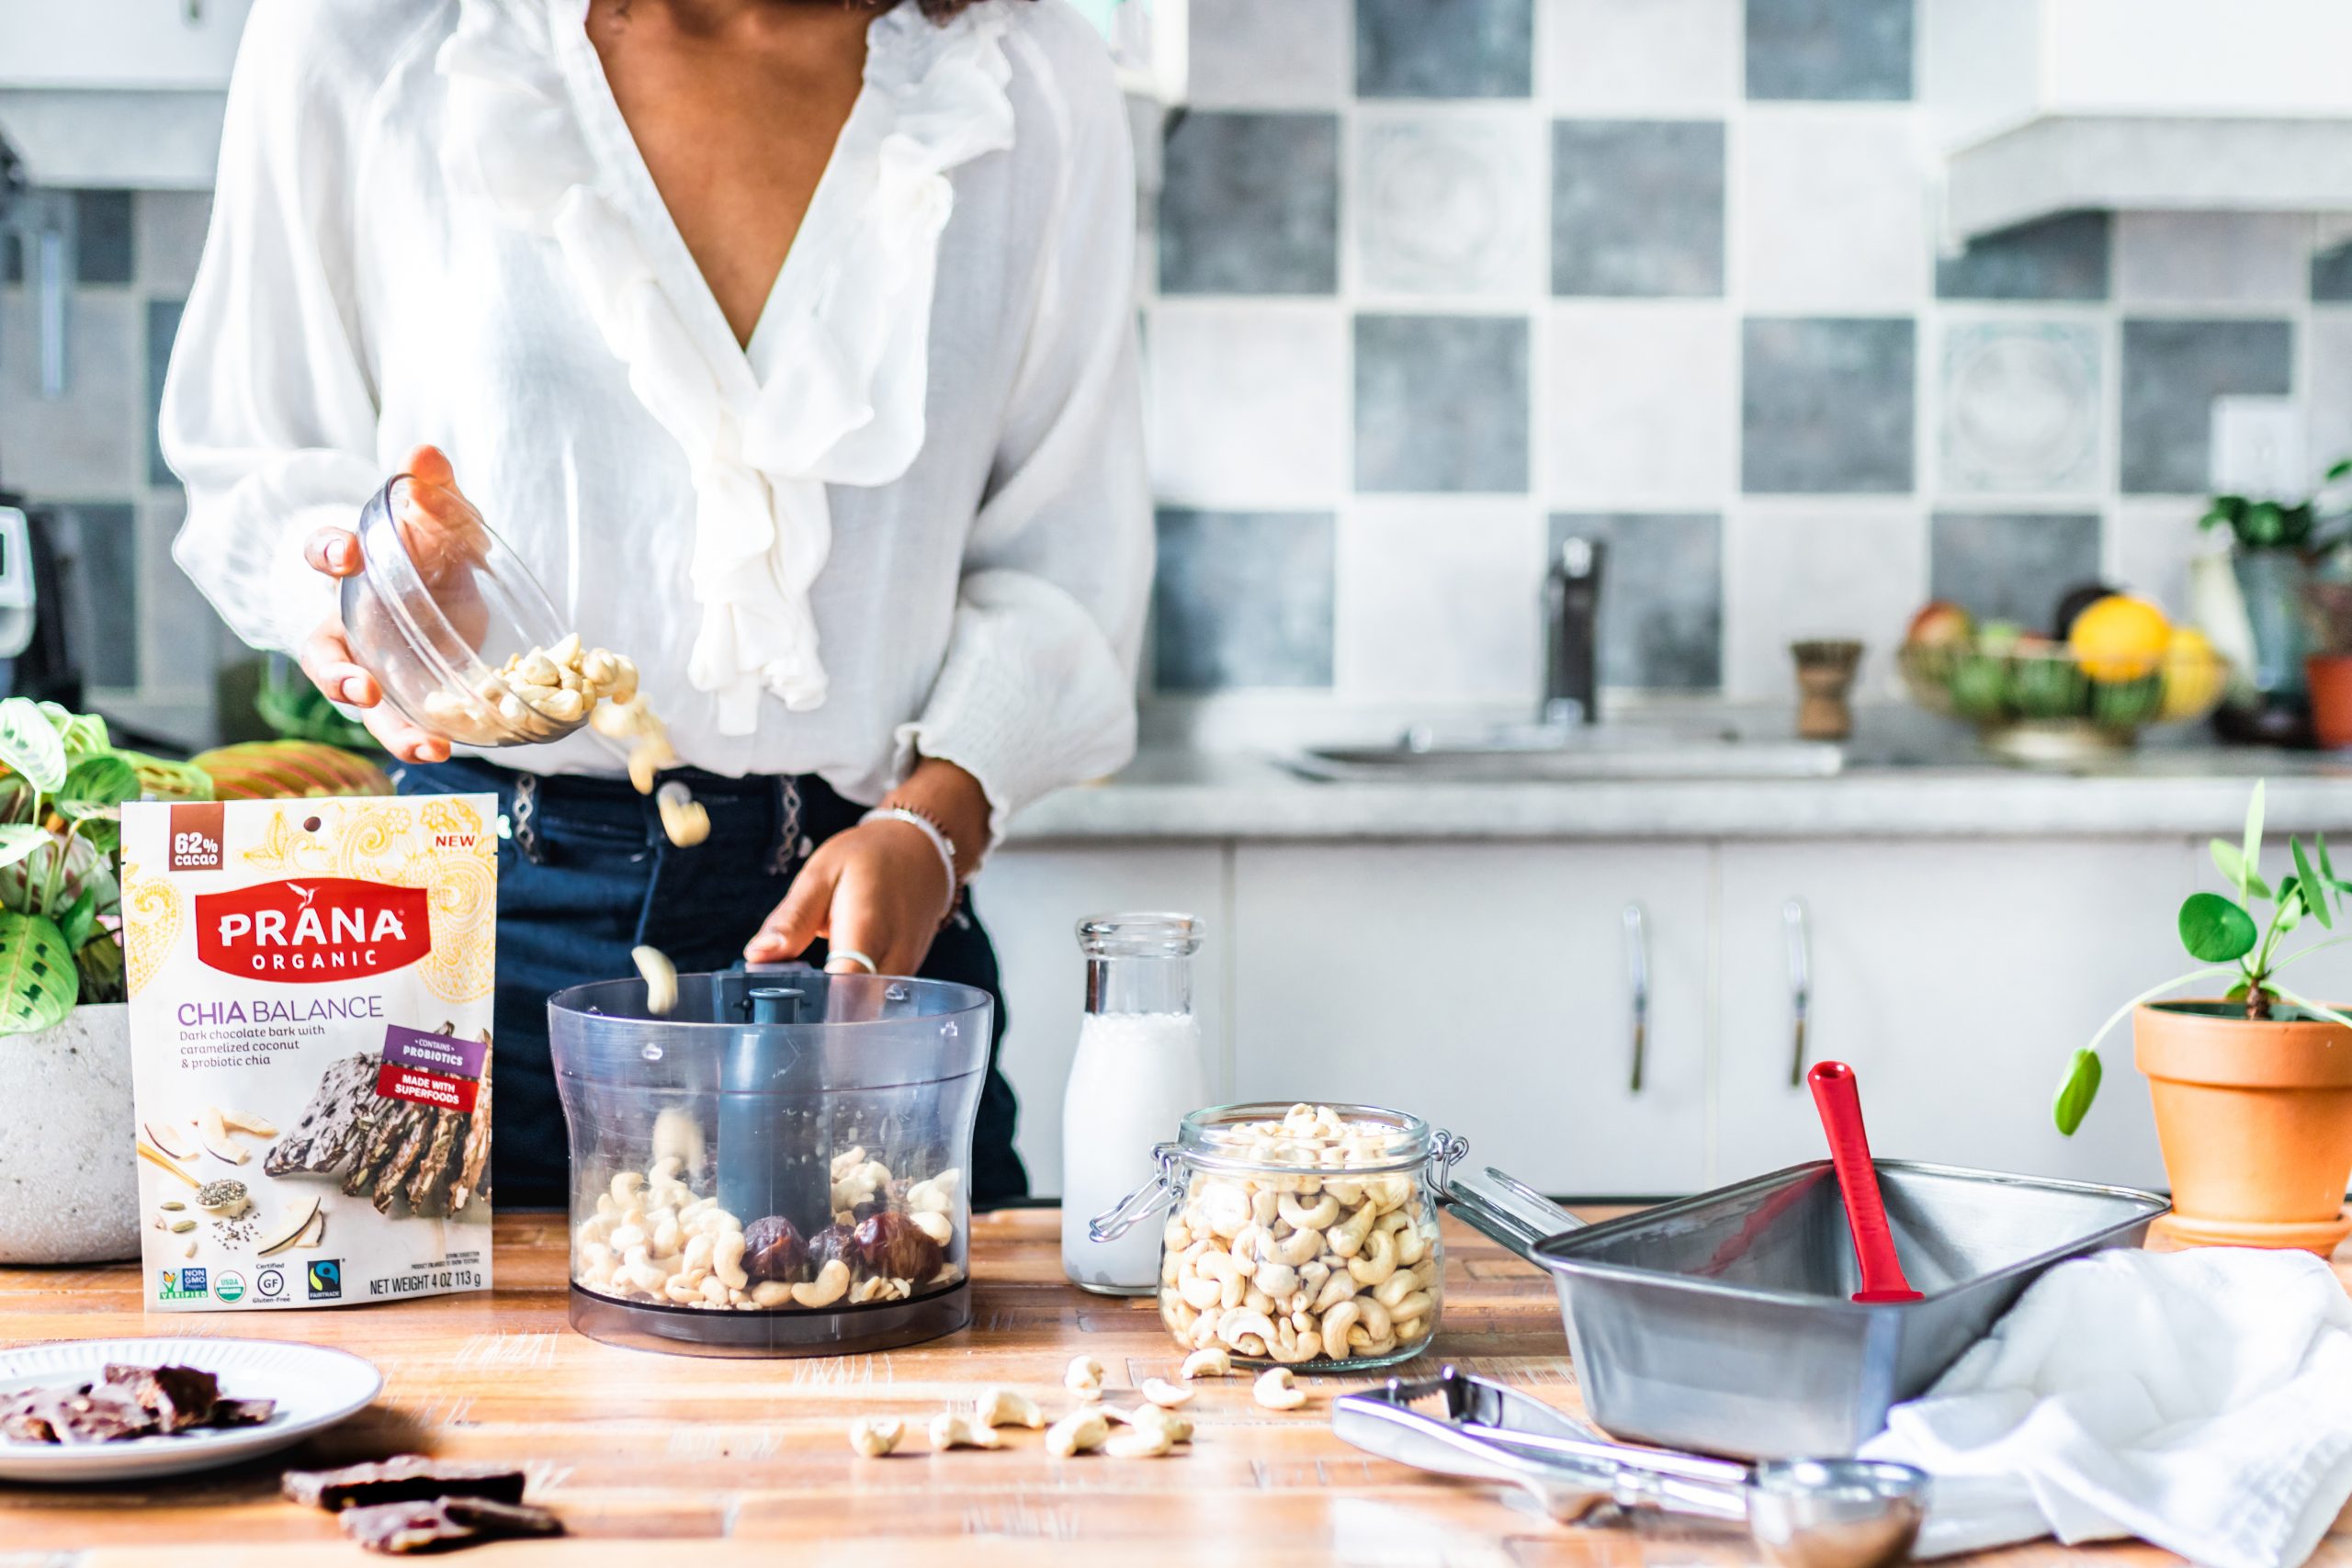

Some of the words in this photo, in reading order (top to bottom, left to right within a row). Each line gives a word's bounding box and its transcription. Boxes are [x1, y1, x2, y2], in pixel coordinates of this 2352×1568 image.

[175, 831, 219, 854] 62%
[435, 835, 475, 847] NEW
[175, 854, 218, 866] cacao
[252, 950, 377, 970] ORGANIC
[177, 1000, 247, 1026] CHIA
[253, 995, 384, 1022] BALANCE
[180, 1030, 207, 1041] Dark
[209, 1026, 266, 1040] chocolate
[269, 1024, 295, 1037] bark
[298, 1023, 325, 1035] with
[180, 1042, 250, 1055] caramelized
[252, 1040, 300, 1052] coconut
[419, 1039, 451, 1052] CONTAINS
[181, 1058, 189, 1068] &
[192, 1055, 243, 1069] probiotic
[245, 1054, 271, 1066] chia
[402, 1045, 463, 1066] PROBIOTICS
[401, 1074, 430, 1089] MADE
[432, 1079, 456, 1093] WITH
[394, 1084, 460, 1105] SUPERFOODS
[263, 1279, 278, 1288] GF
[370, 1279, 390, 1294] NET
[392, 1274, 429, 1292] WEIGHT
[432, 1273, 437, 1288] 4
[440, 1272, 452, 1288] OZ
[456, 1270, 471, 1286] 113
[474, 1273, 481, 1288] g
[160, 1291, 208, 1300] VERIFIED
